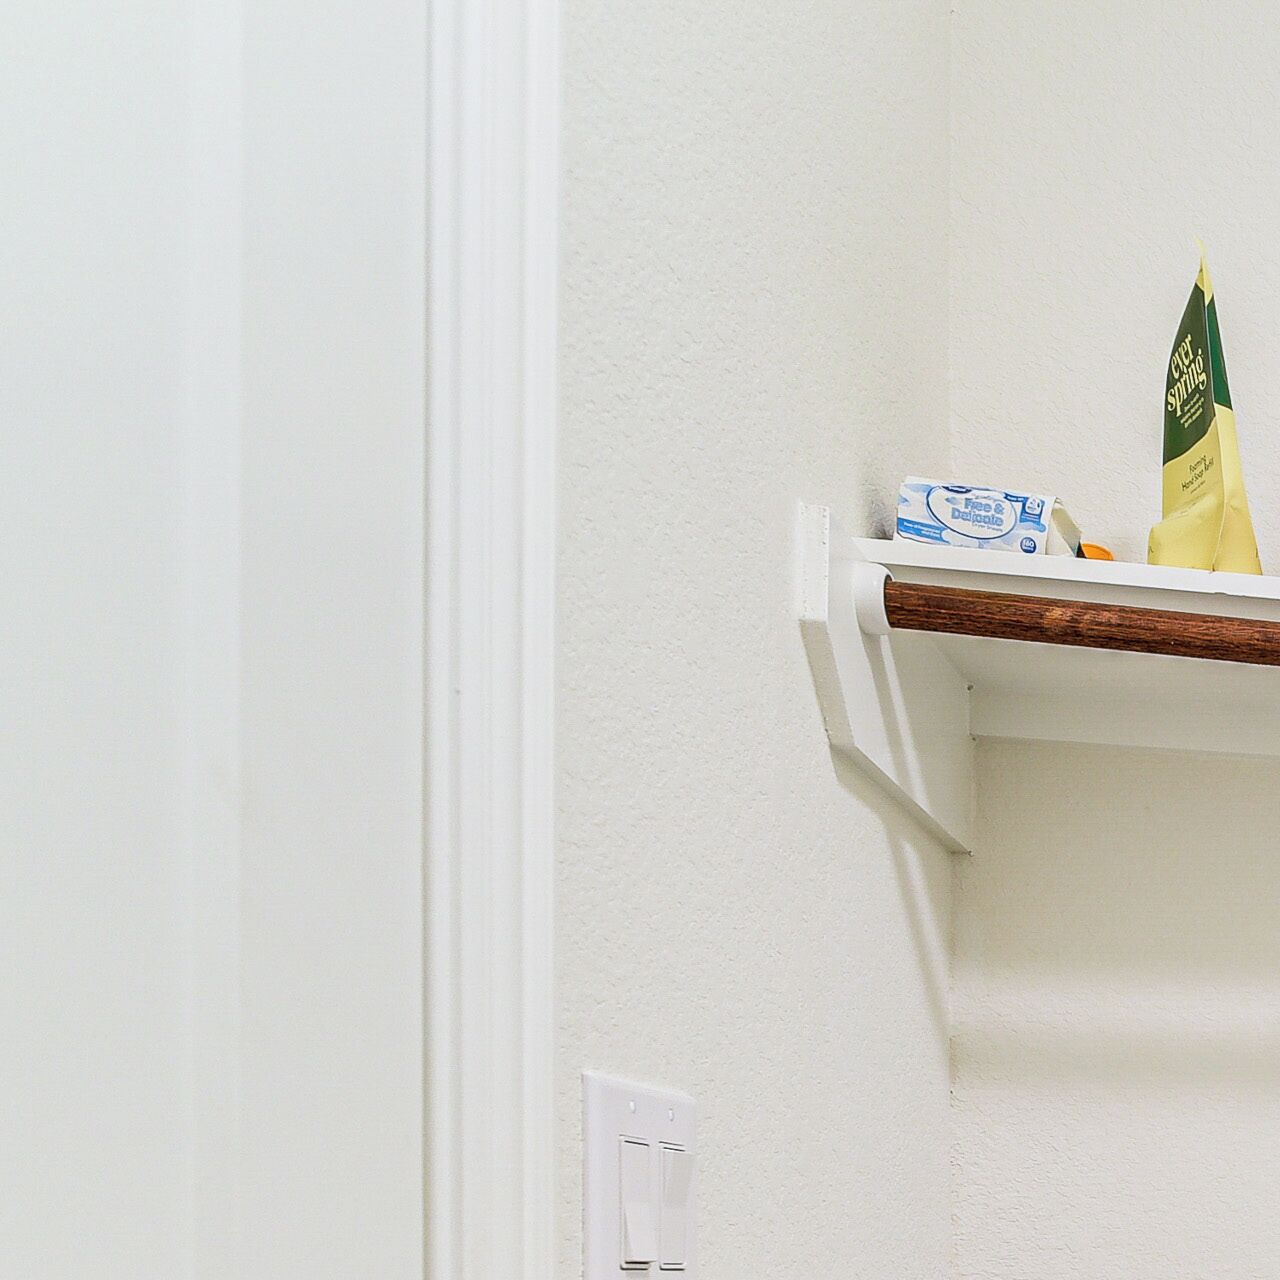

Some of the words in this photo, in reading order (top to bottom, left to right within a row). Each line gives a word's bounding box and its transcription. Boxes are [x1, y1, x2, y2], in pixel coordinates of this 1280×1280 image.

[1171, 334, 1194, 379] ever
[1167, 348, 1207, 417] spring
[994, 503, 1005, 514] &
